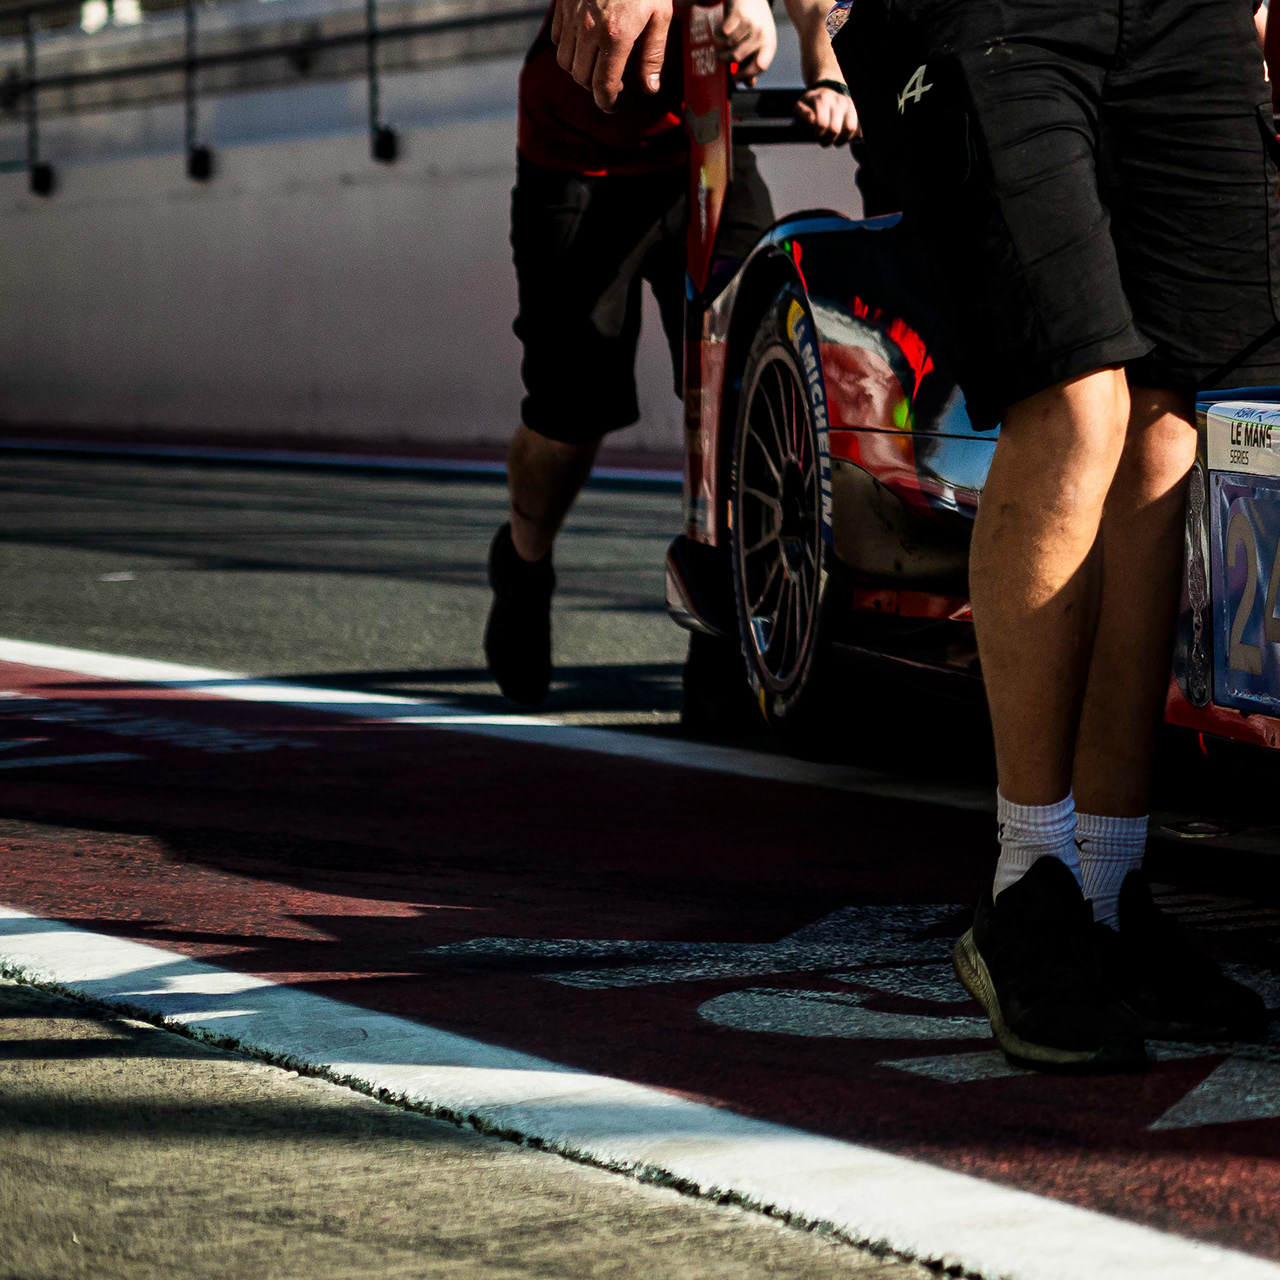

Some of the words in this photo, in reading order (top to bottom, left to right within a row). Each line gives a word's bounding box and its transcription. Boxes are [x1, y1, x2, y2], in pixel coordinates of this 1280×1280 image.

[801, 342, 833, 528] MICHELIN
[1230, 421, 1242, 446] LE
[1244, 422, 1273, 449] MANS
[1230, 449, 1249, 465] SERIES
